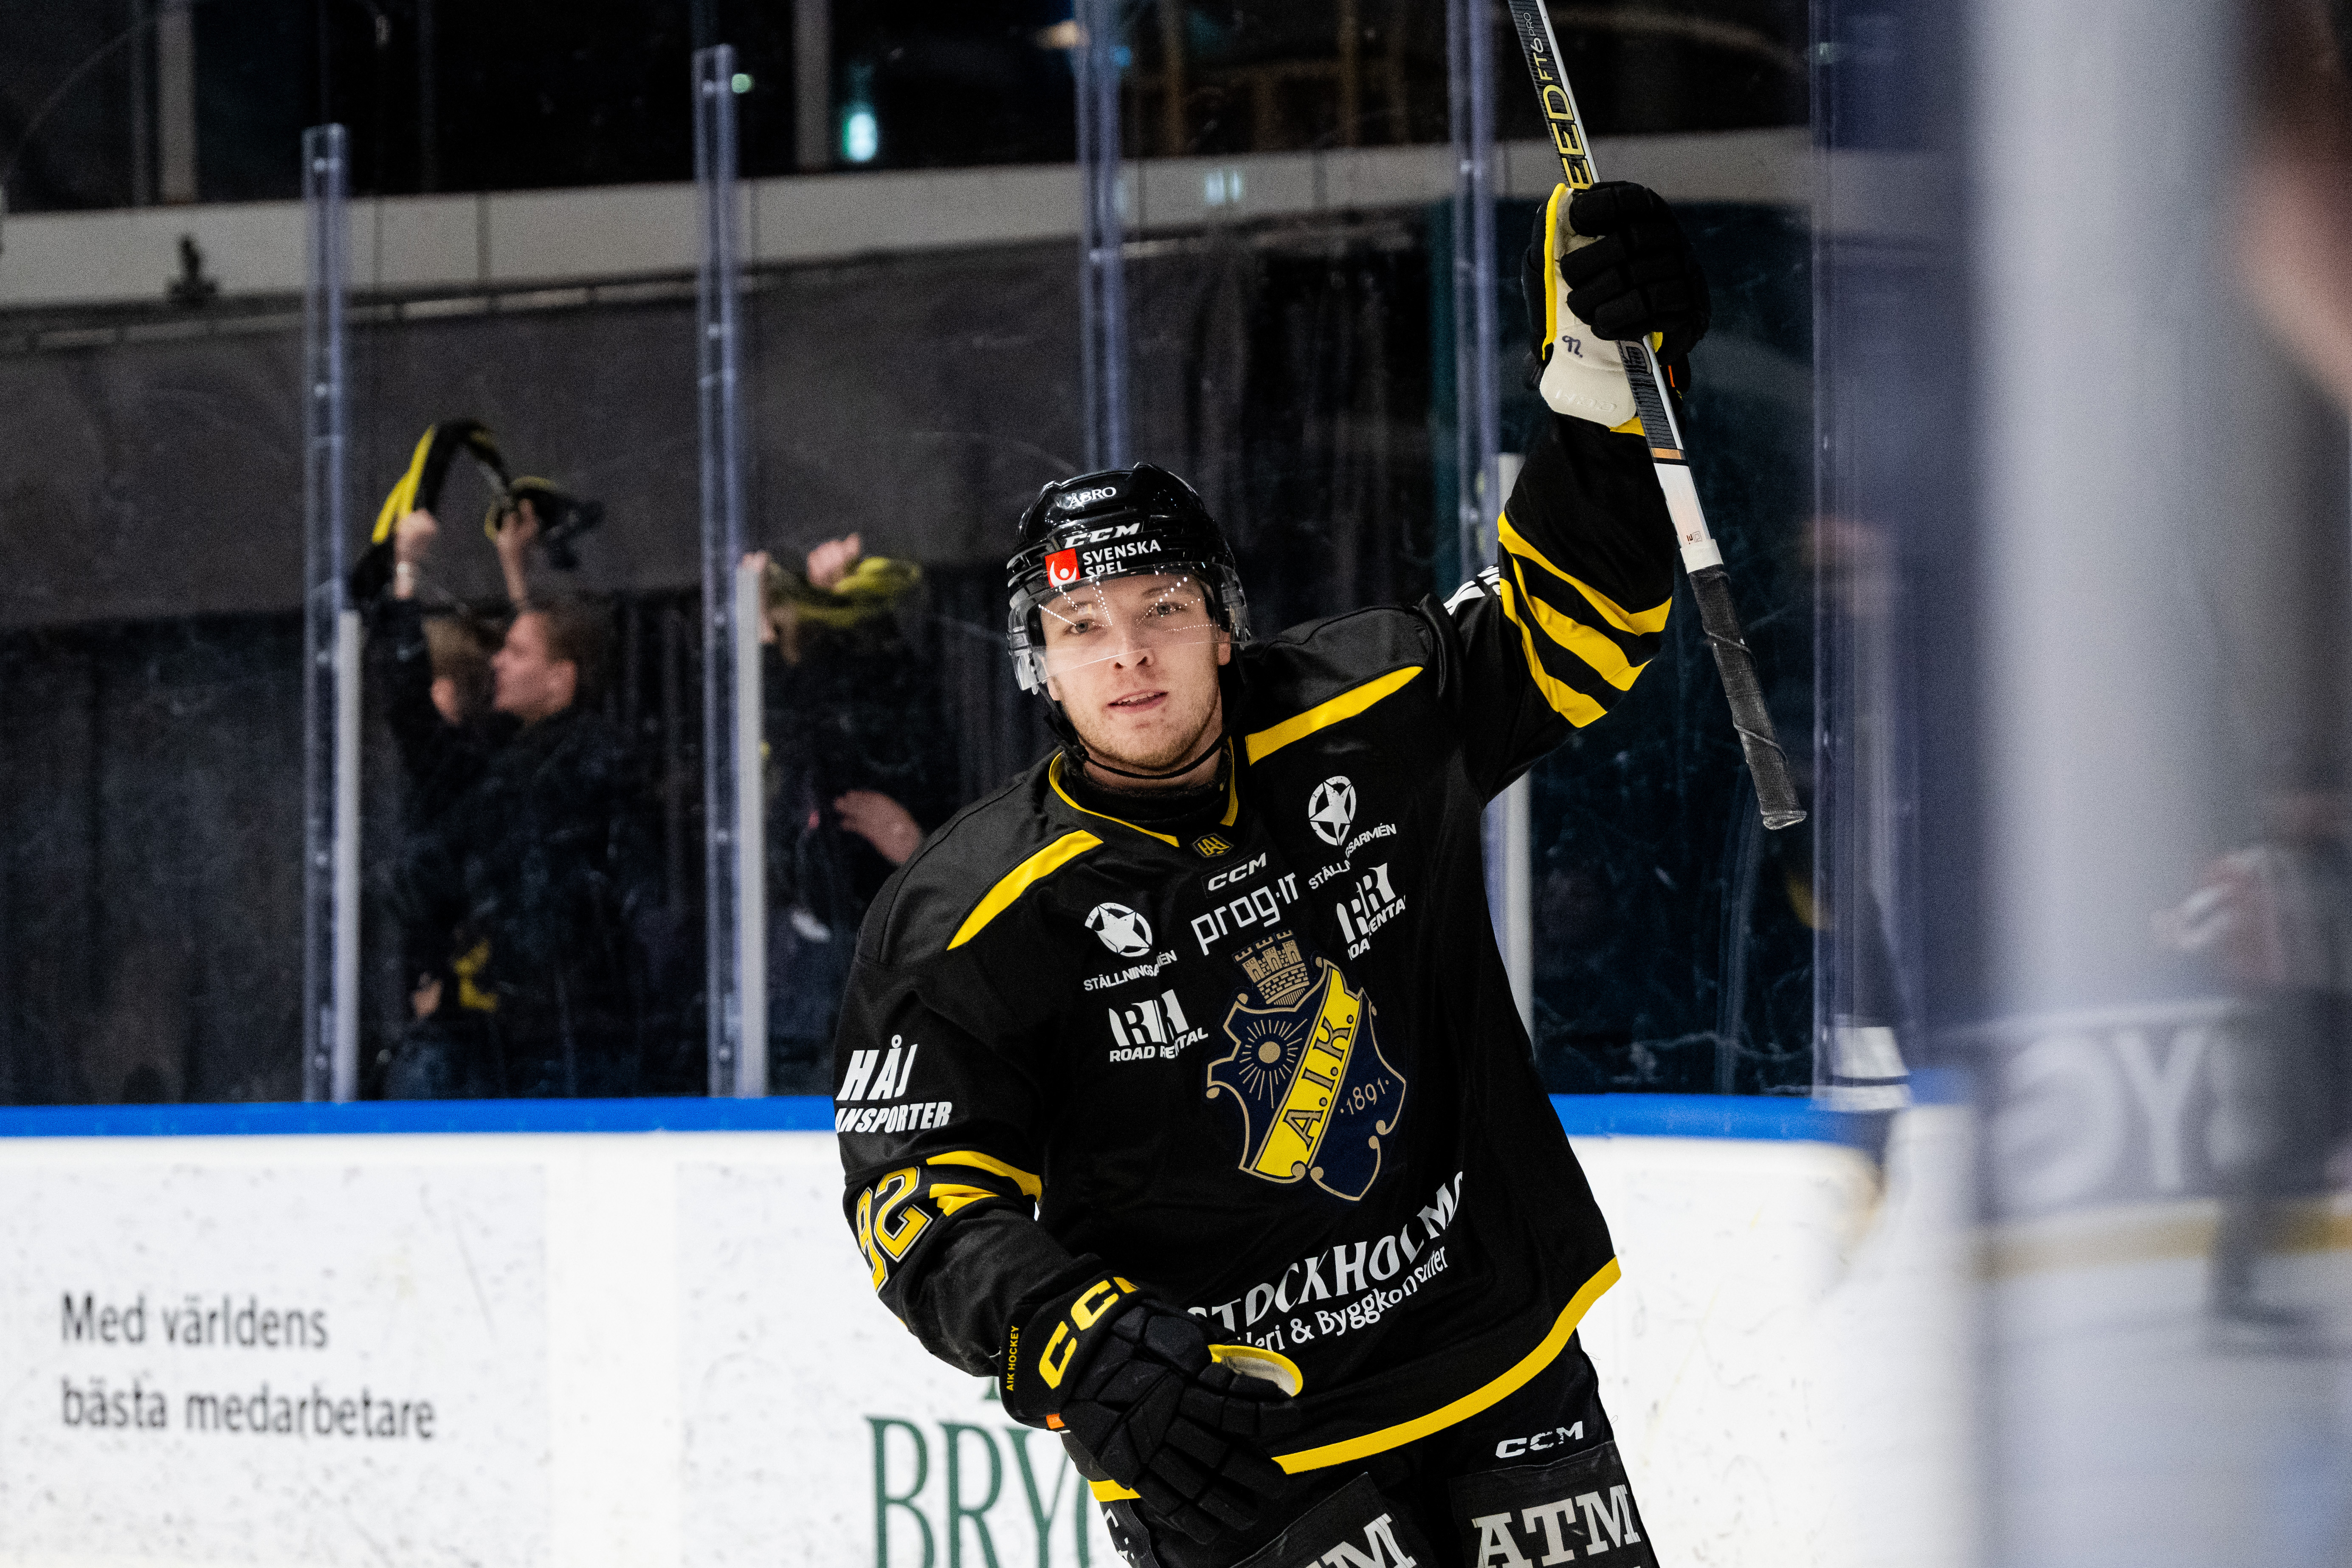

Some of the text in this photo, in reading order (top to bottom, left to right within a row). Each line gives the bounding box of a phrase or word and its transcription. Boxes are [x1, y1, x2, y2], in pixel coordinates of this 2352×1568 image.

[1523, 12, 1537, 37] PRO
[1067, 487, 1117, 509] ÅBRO
[1065, 523, 1141, 549] CCM
[1083, 539, 1161, 565] SVENSKA
[1085, 561, 1127, 577] SPEL
[1208, 852, 1266, 891] CCM
[1369, 894, 1406, 936] ENTA
[836, 1034, 918, 1101] HÅJ
[1110, 1046, 1155, 1062] ROAD
[856, 1166, 933, 1296] 92
[62, 1291, 329, 1349] Med världens
[1290, 1318, 1315, 1343] &
[1006, 1326, 1019, 1391] AIK HOCKEY
[62, 1376, 437, 1440] bästa medarbetare
[1496, 1421, 1583, 1458] CCM
[863, 1415, 1090, 1568] BRY
[1471, 1484, 1641, 1568] ATM
